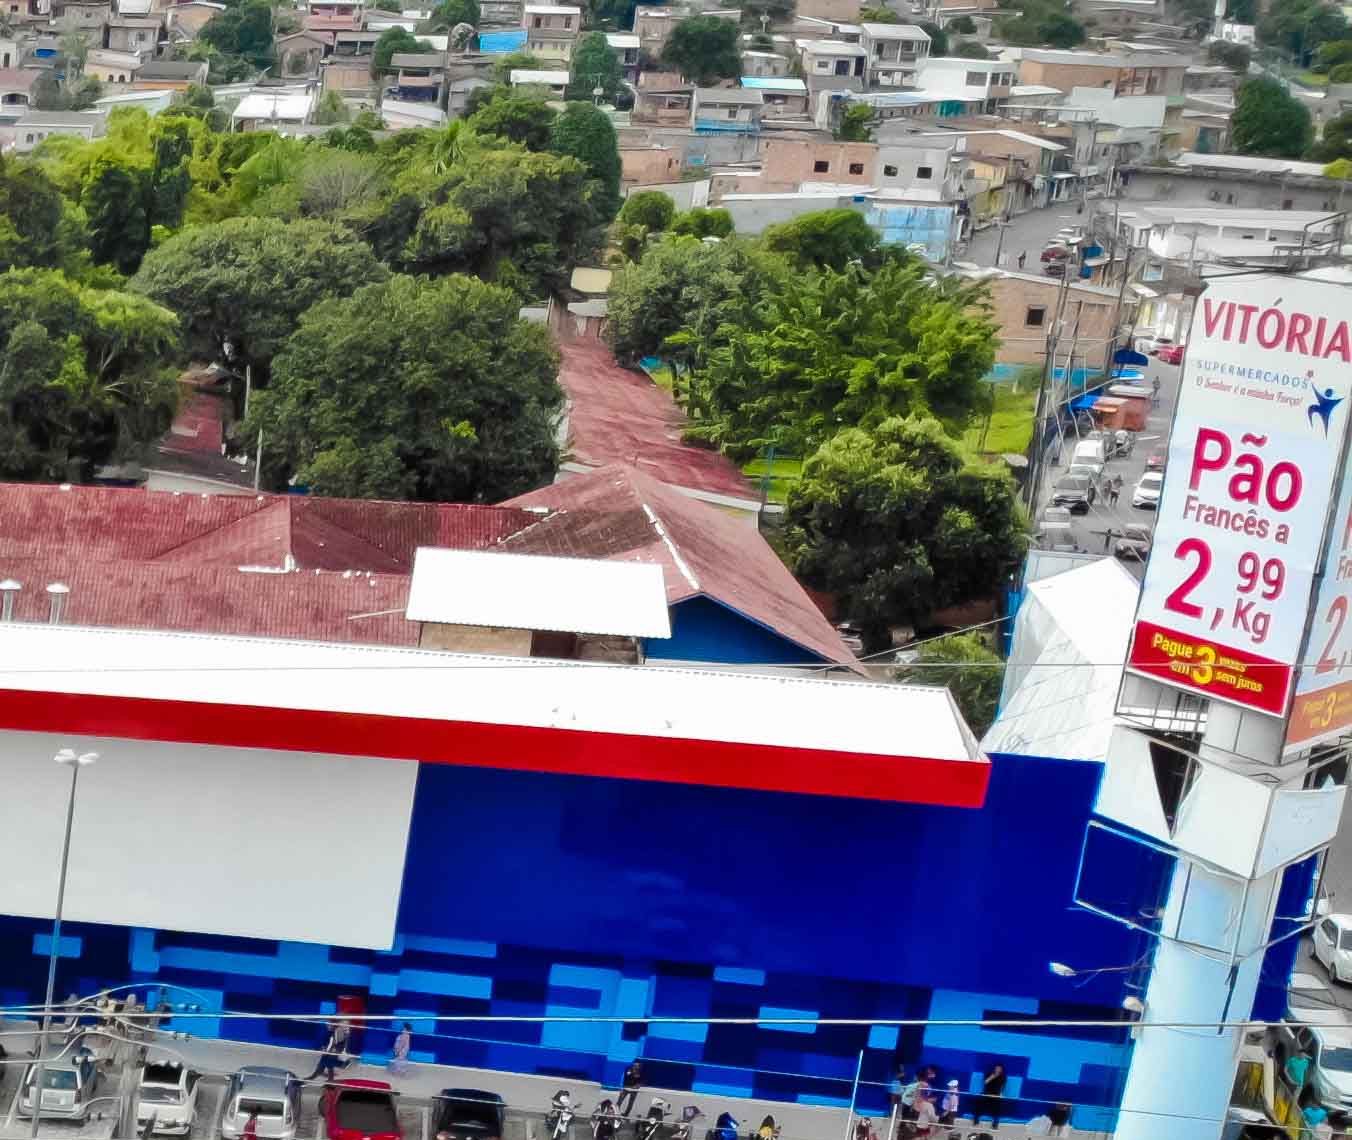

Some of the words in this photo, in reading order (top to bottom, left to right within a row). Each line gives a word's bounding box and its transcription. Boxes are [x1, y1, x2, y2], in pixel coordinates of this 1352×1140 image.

[1203, 297, 1351, 363] VITÓRIA
[1197, 359, 1309, 390] SUPERMERCADOS
[1189, 427, 1303, 513] Pão
[1183, 494, 1270, 539] Francês
[1275, 522, 1290, 545] a
[1232, 598, 1271, 644] Kg
[1153, 632, 1194, 657] Pague
[1193, 646, 1216, 684] 3
